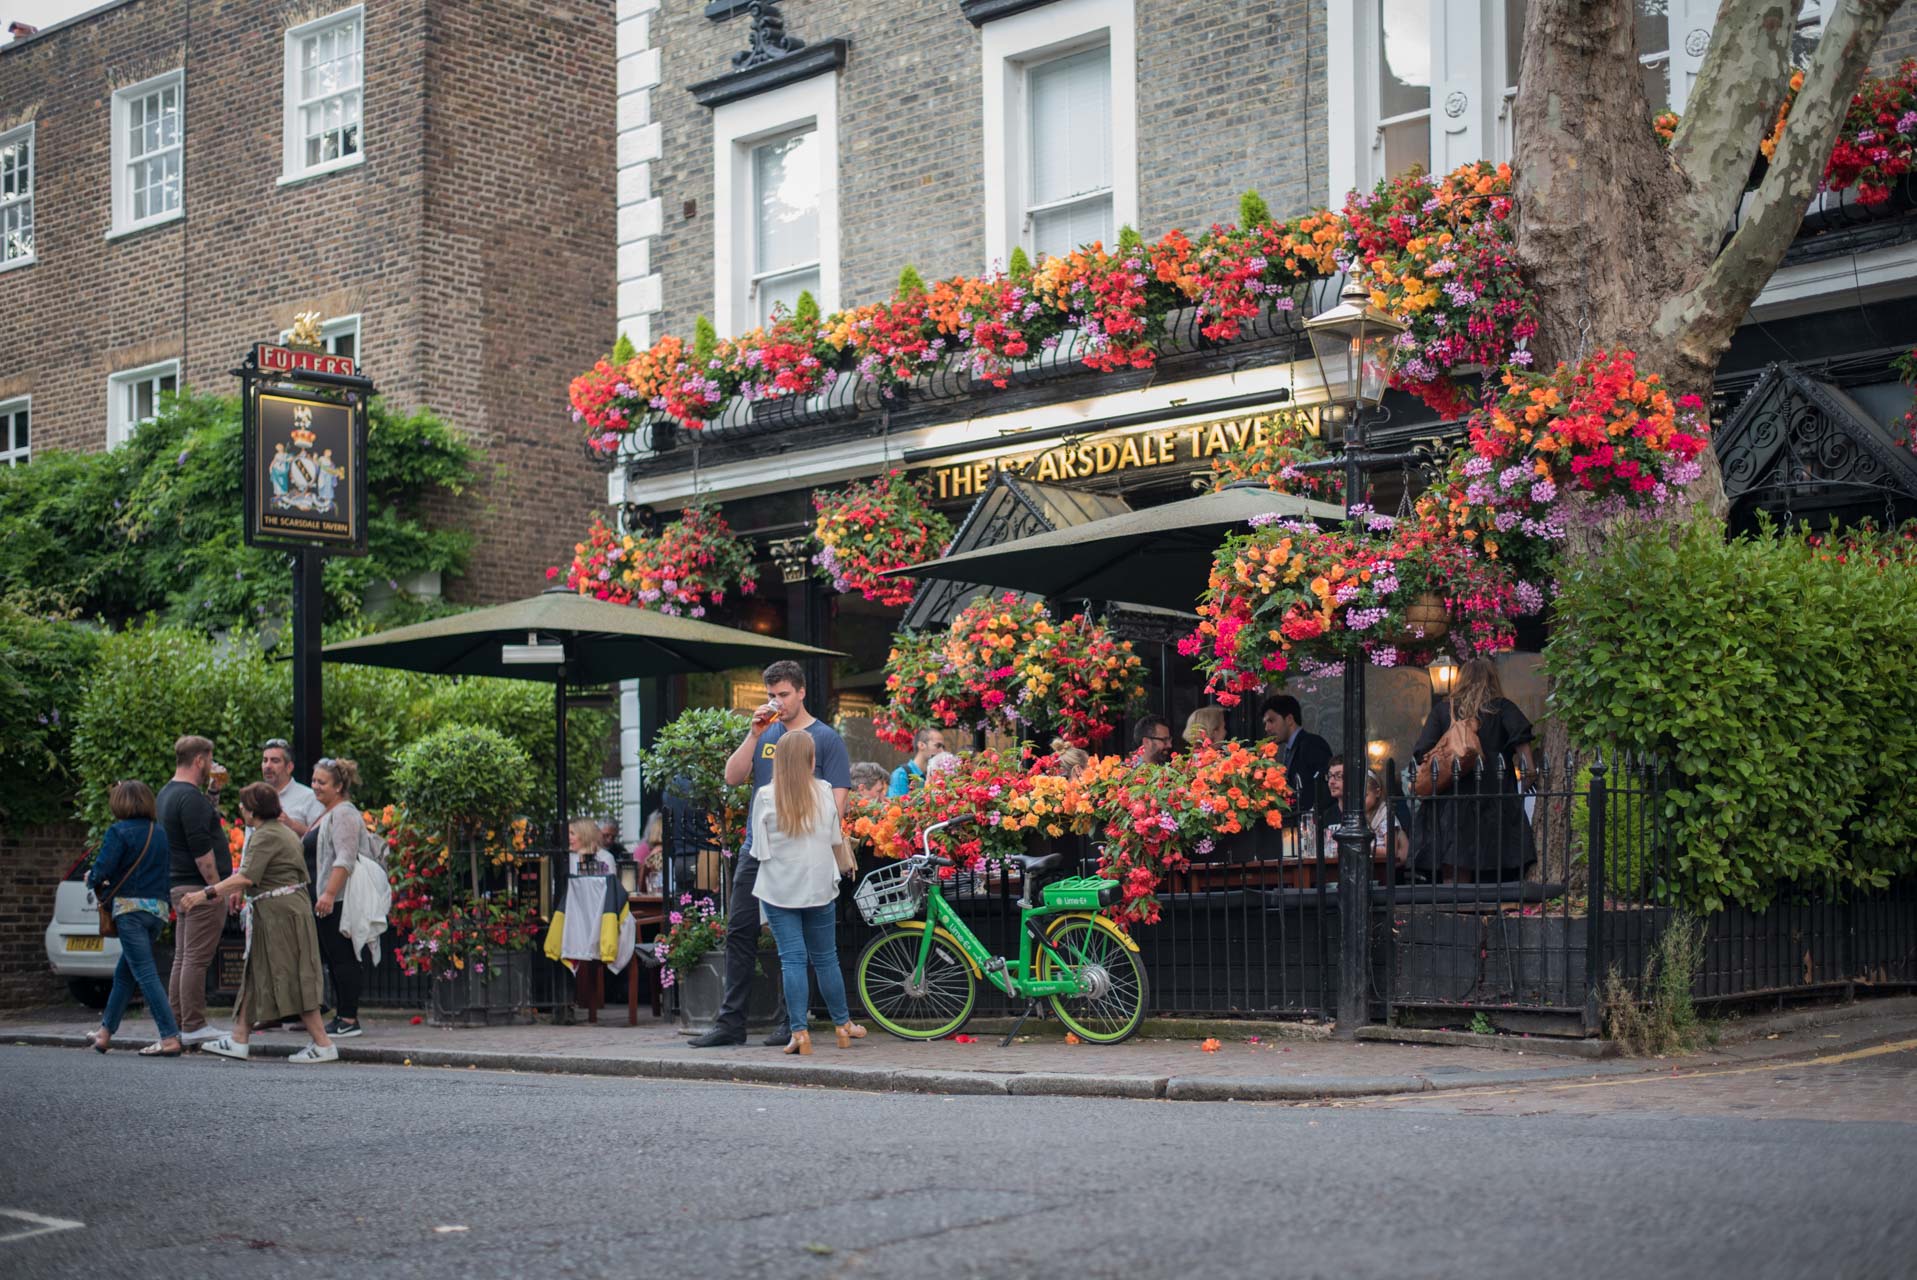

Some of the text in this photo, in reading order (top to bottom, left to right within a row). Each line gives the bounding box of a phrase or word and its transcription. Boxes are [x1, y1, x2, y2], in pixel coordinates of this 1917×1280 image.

[936, 463, 989, 498] THE
[264, 515, 348, 533] THE SCARSDALE TAVERN
